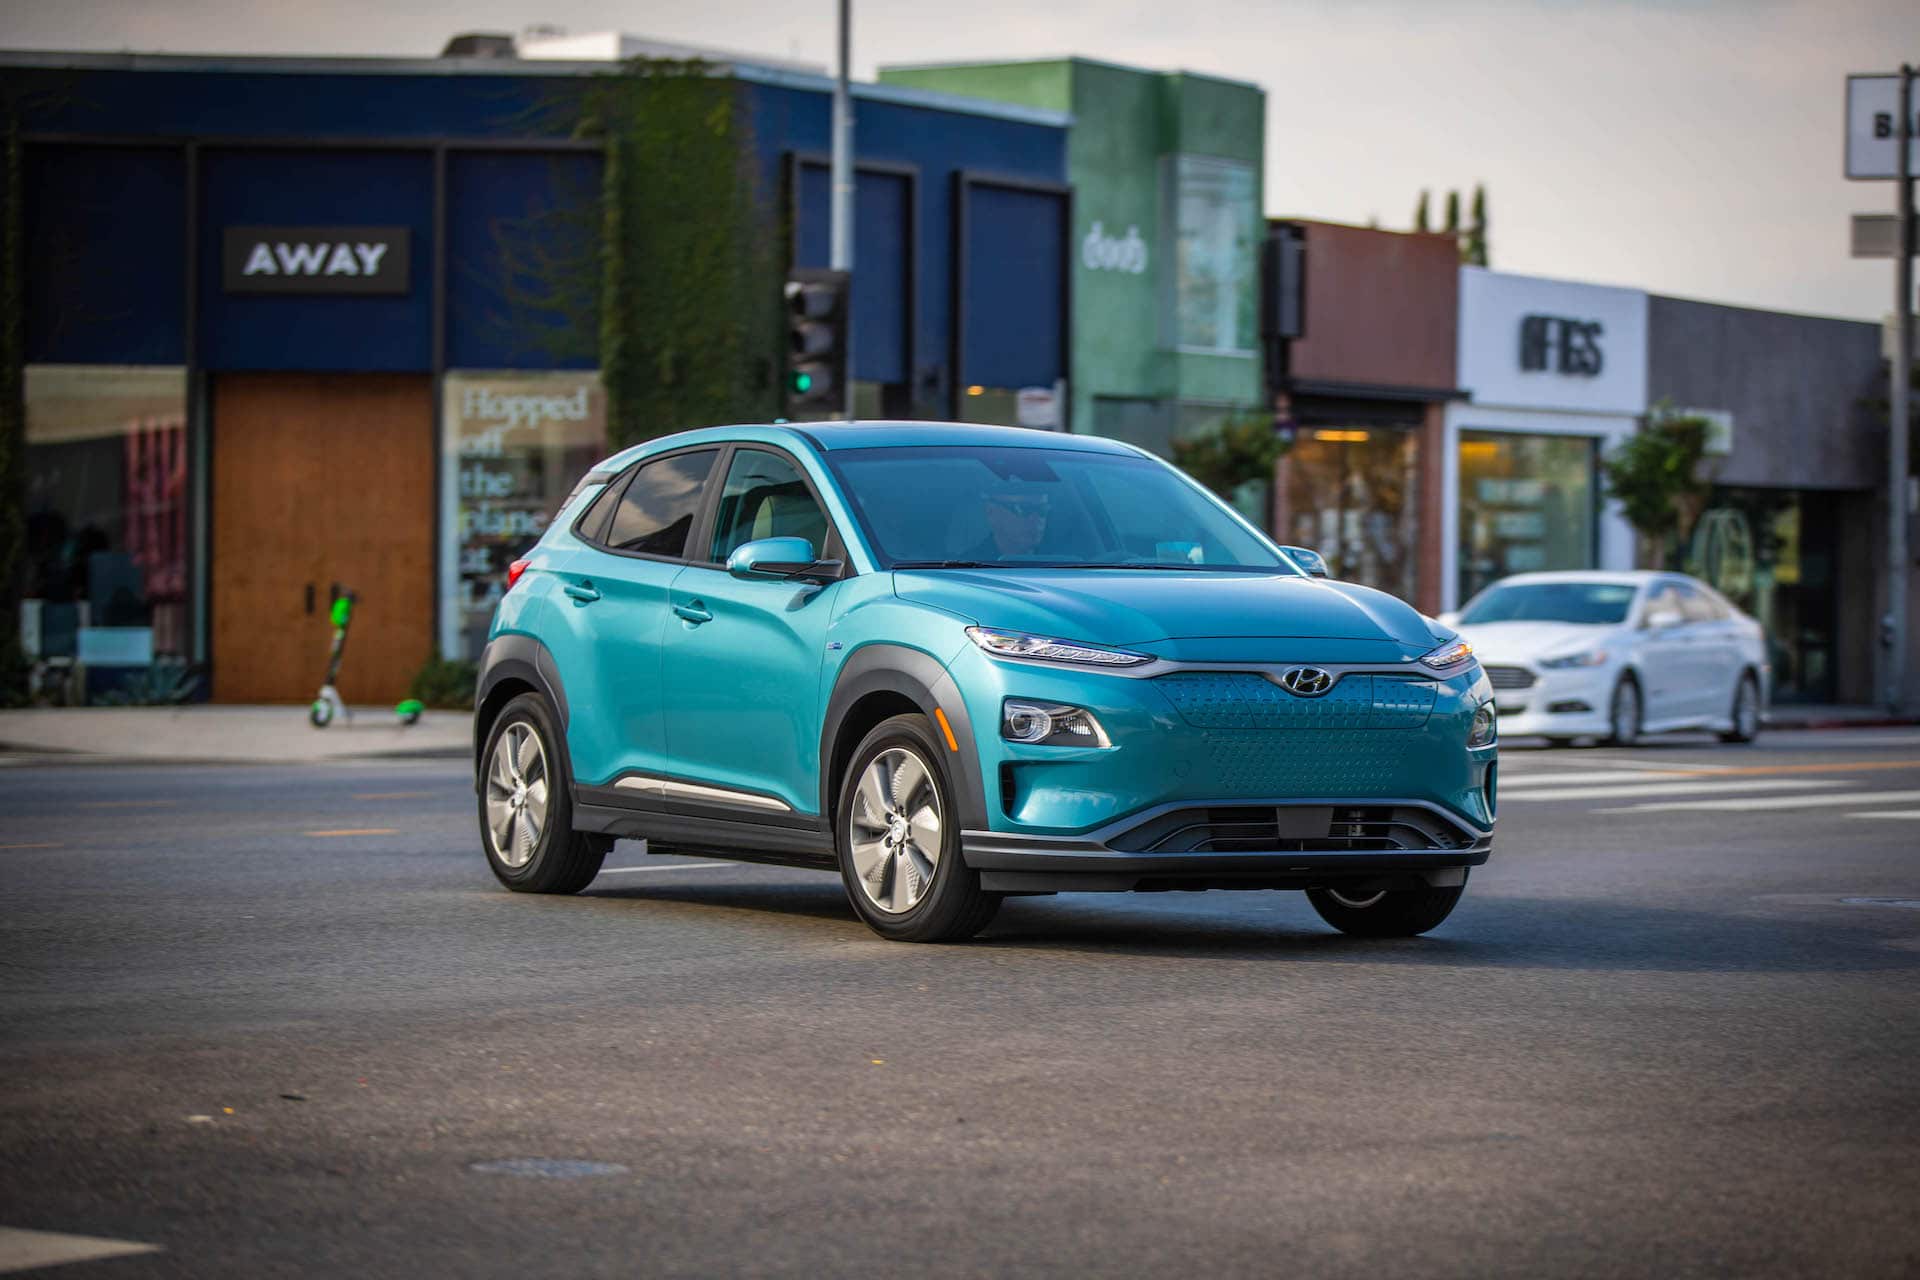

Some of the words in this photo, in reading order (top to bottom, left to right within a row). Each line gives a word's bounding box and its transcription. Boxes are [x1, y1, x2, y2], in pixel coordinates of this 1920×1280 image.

[242, 241, 388, 276] AWAY
[462, 386, 589, 429] Hopped
[460, 462, 513, 497] the
